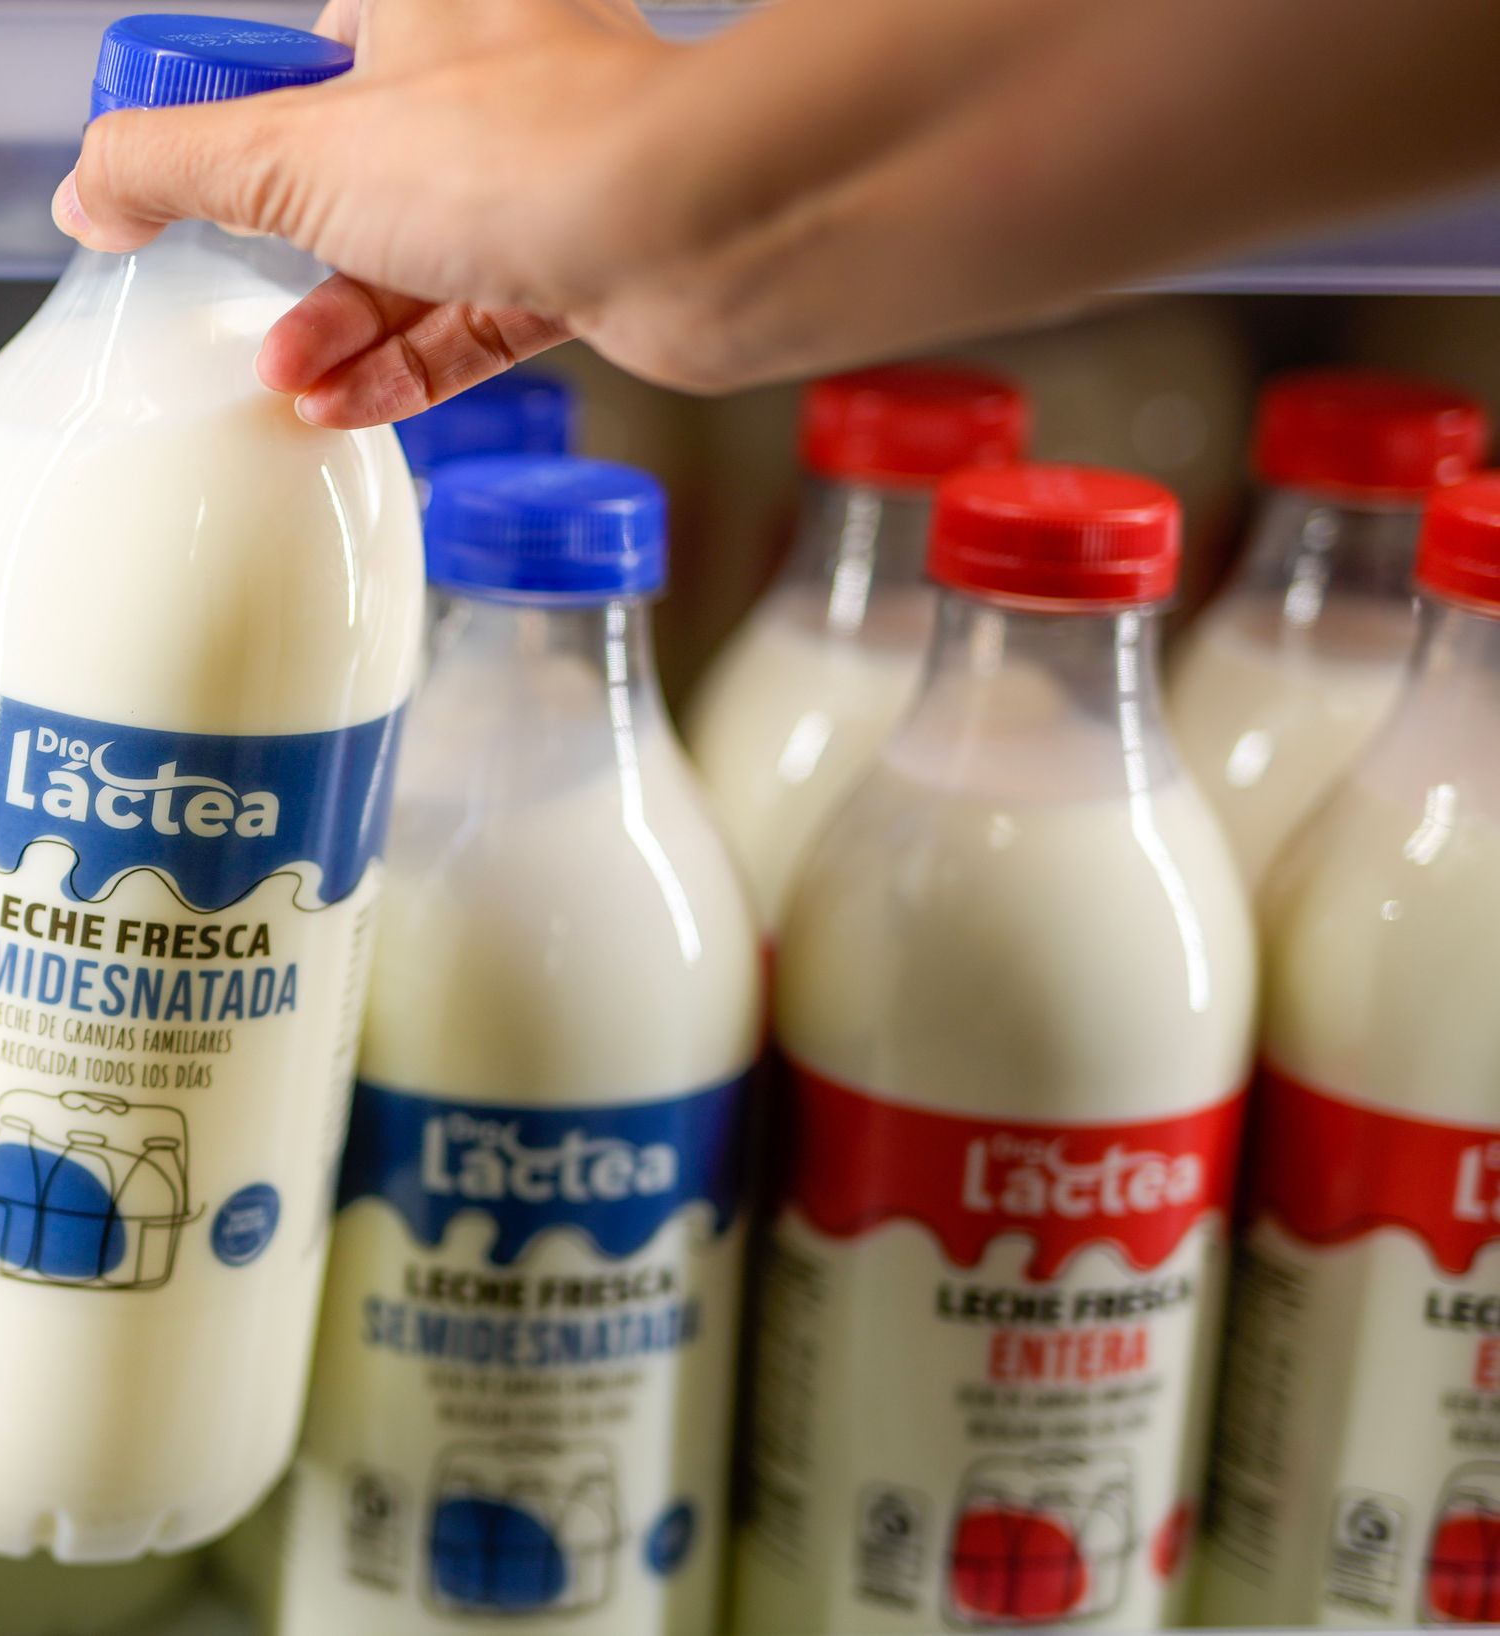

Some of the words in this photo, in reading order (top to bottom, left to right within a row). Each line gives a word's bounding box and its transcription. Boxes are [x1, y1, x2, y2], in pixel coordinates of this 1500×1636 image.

[5, 729, 279, 838] Láctea
[115, 919, 271, 960] FRESCA
[37, 1015, 56, 1040] DE
[63, 1018, 136, 1052] GRANJAS
[143, 1029, 233, 1055] FAMILIARES
[1, 1040, 77, 1080] RECOGIDA
[84, 1057, 136, 1087] TODOS
[141, 1064, 169, 1089] LOS
[175, 1061, 213, 1089] DÍAS
[936, 1282, 1062, 1323] LECHE
[987, 1327, 1148, 1384] ENTERA
